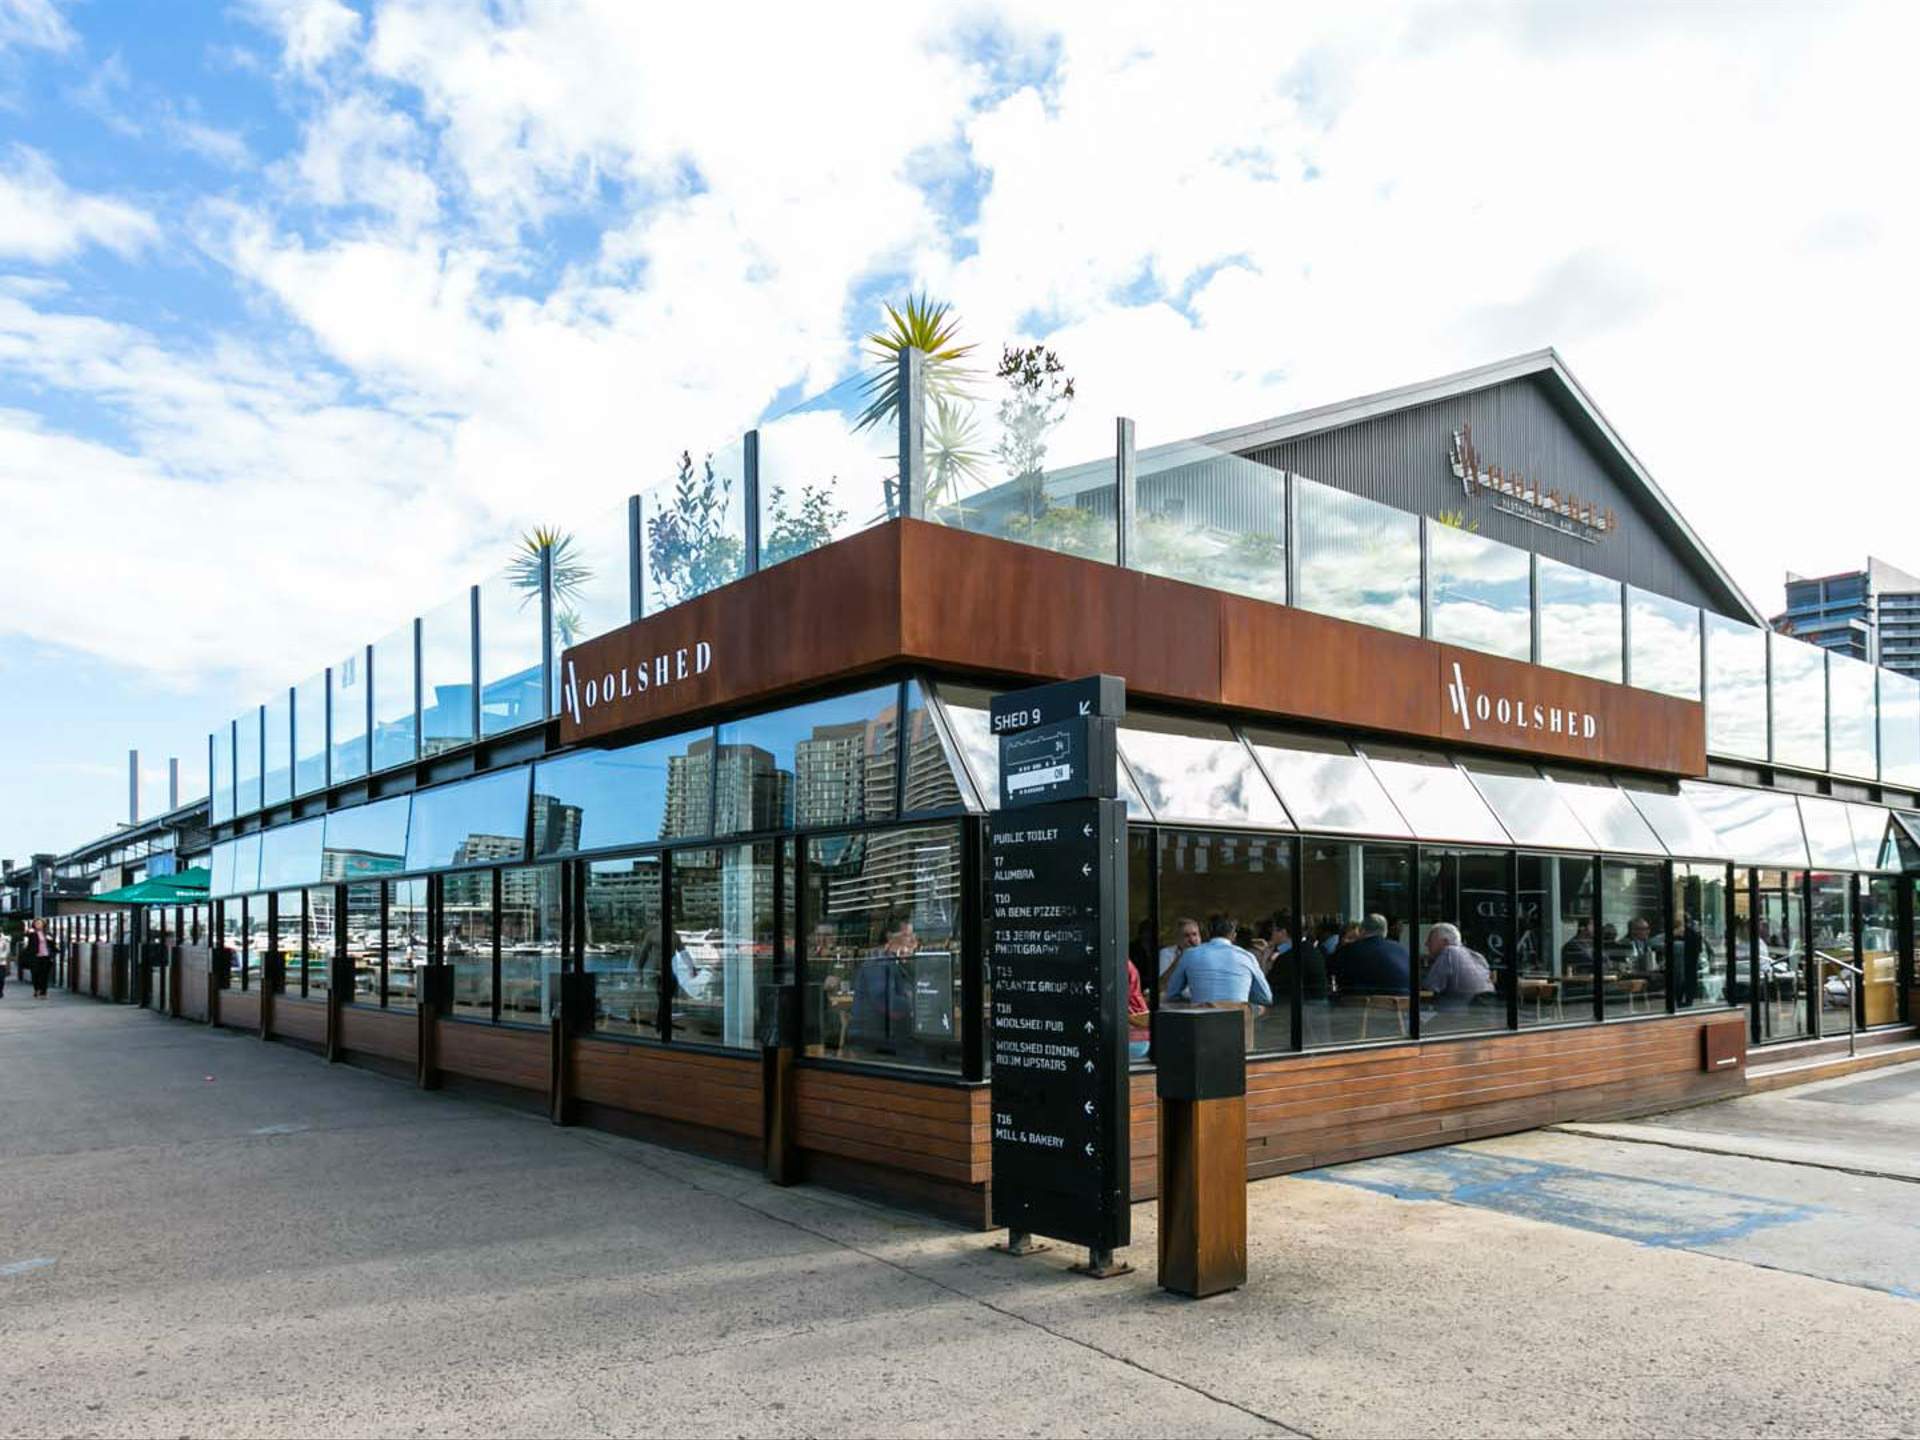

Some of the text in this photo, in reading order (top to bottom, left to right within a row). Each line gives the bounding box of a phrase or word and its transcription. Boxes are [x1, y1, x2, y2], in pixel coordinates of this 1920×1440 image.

[565, 641, 712, 725] WOOLSHED
[1448, 662, 1596, 739] WOOLSHED
[994, 708, 1041, 731] SHED 9
[993, 829, 1058, 844] PUBLIC TOILET
[993, 856, 1004, 867] T7
[994, 869, 1035, 881] ALUMBRA
[994, 893, 1010, 904] T10
[995, 907, 1006, 918] VA
[1008, 906, 1032, 917] BENE
[995, 1017, 1064, 1032] WOOLSHED PUB
[995, 1041, 1080, 1058] WOOLSHED DINING
[1022, 1057, 1067, 1071] UPSTAIRS
[996, 1113, 1012, 1125] T16
[995, 1128, 1064, 1149] MILL & BAKERY
